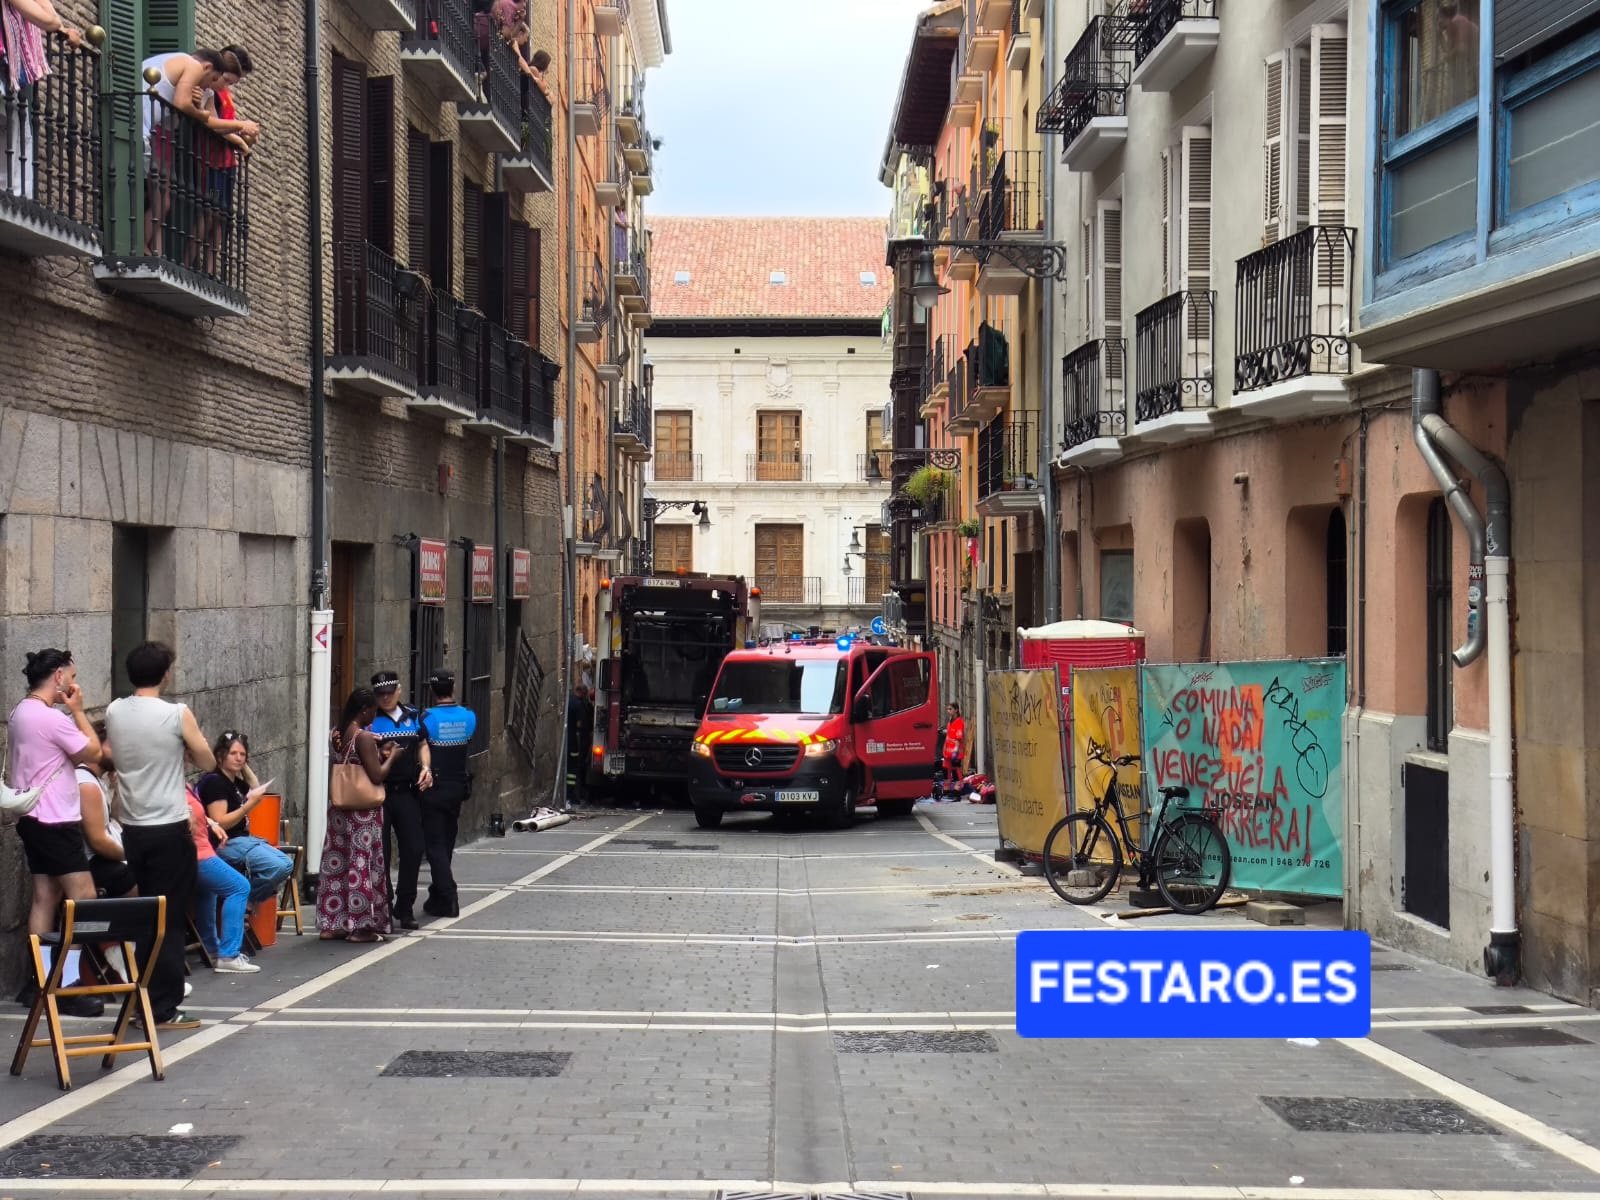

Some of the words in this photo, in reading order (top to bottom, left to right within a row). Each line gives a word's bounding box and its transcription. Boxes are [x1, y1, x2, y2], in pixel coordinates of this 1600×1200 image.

[1172, 686, 1259, 719] COMUNA
[1176, 718, 1191, 740] O
[780, 792, 800, 800] 0103
[802, 792, 817, 800] KVJ
[1276, 857, 1293, 866] 948
[1314, 859, 1330, 868] 726
